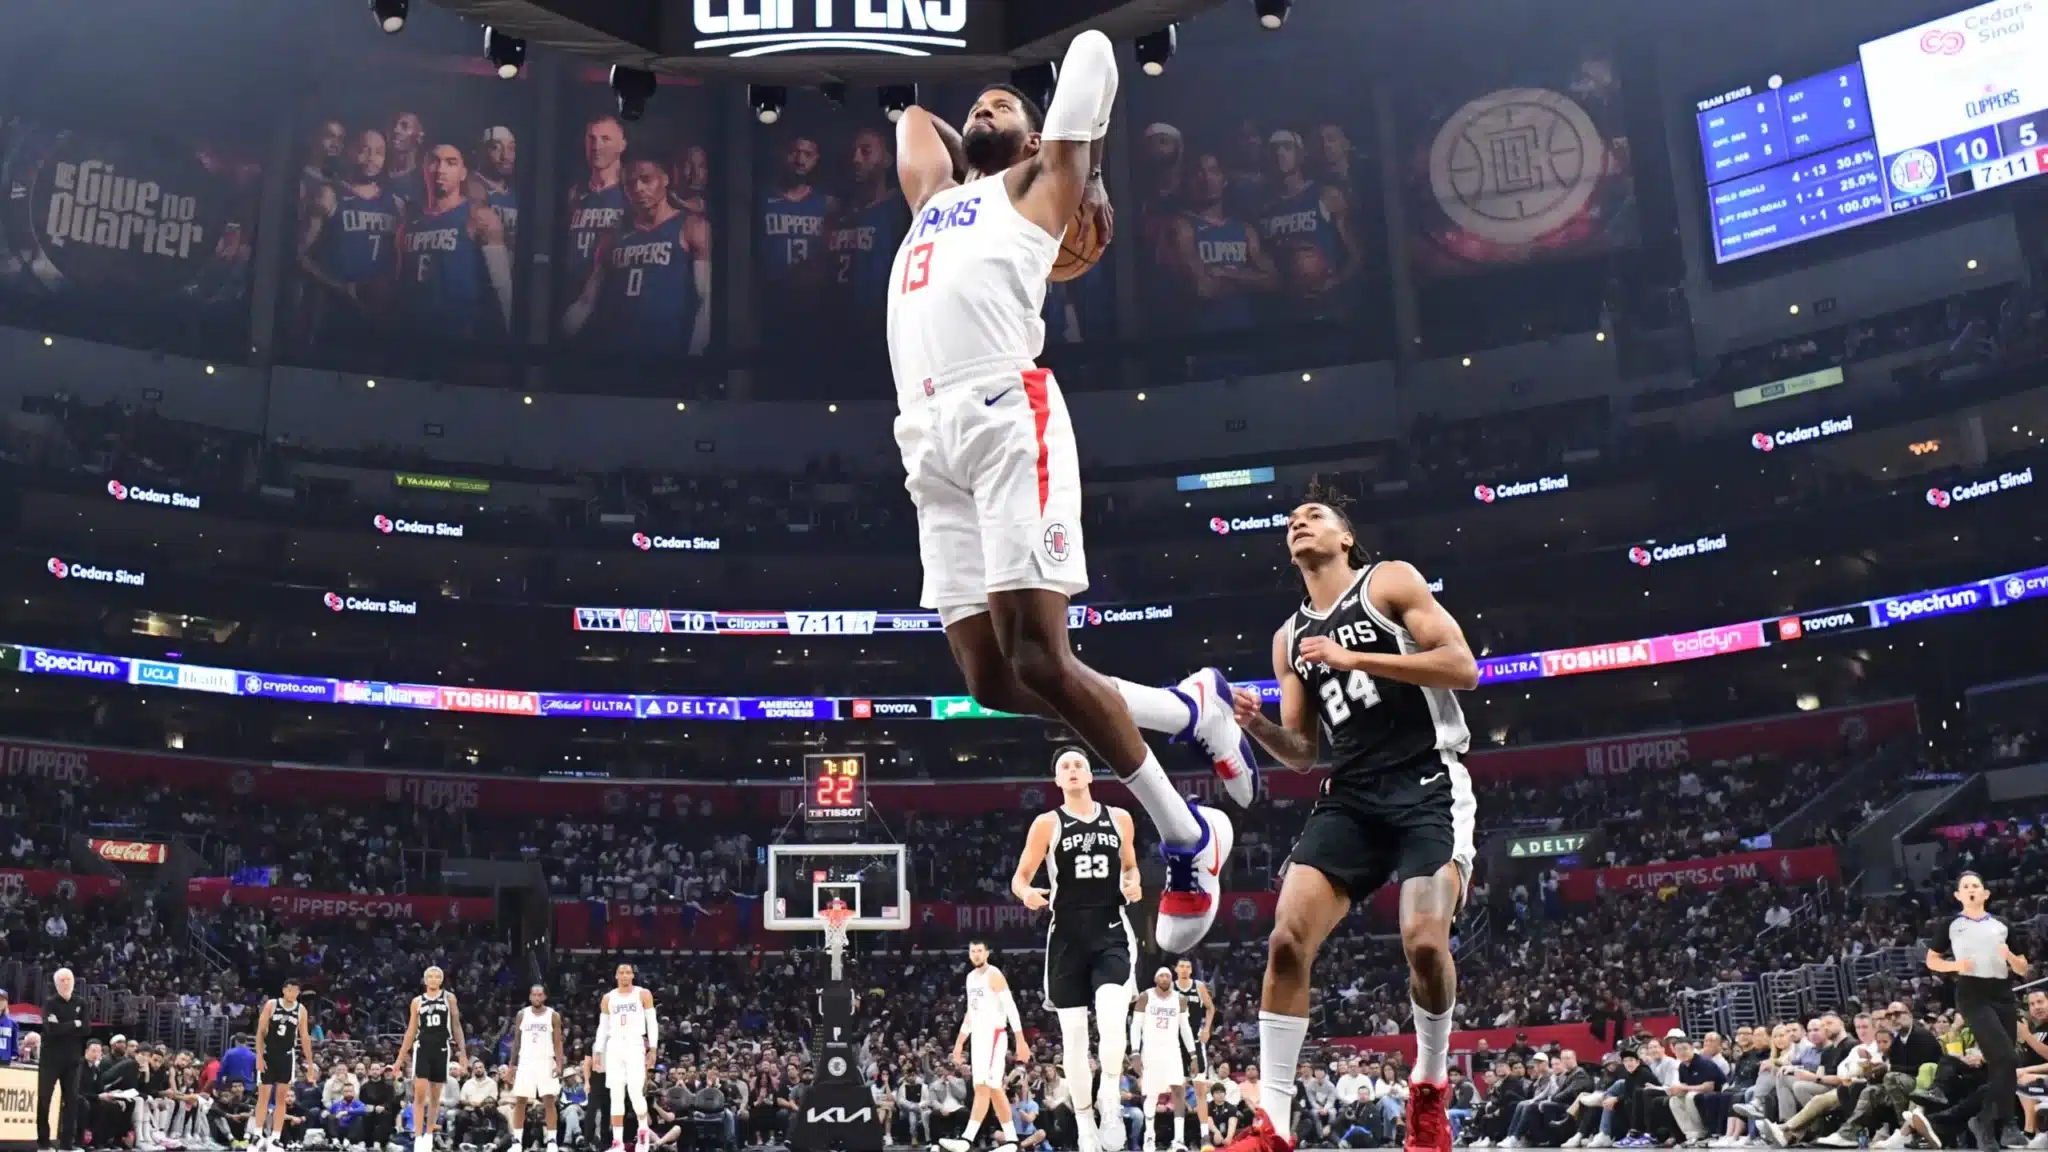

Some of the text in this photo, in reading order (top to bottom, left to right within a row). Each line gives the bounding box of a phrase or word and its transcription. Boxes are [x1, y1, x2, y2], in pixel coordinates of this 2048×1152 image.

[1965, 1, 2033, 30] Cedars
[1979, 19, 2025, 43] Sinai
[1697, 86, 1752, 111] TEAM STATS
[1966, 88, 2020, 118] CLIPPERS
[1955, 122, 2038, 164] 10 5
[1739, 183, 1766, 198] GOALS
[1812, 164, 1827, 177] 13
[1982, 156, 2027, 183] 7:11
[1816, 187, 1824, 198] 4
[1840, 172, 1878, 192] 25.0%
[161, 193, 196, 221] no
[1837, 194, 1882, 215] 100.0%
[47, 192, 203, 259] Quarter
[369, 234, 381, 262] 7
[613, 241, 672, 269] CLIPPERS
[787, 238, 808, 265] 13
[901, 241, 934, 294] 13
[626, 268, 643, 297] 0
[1776, 415, 1853, 445] Cedars Sinai
[1200, 469, 1250, 481] AMERICAN
[1207, 477, 1251, 489] EXPRESS
[1497, 474, 1568, 498] Cedars Sinai
[1952, 467, 2033, 501] Cedars Sinai
[130, 487, 200, 508] Cedars Sinai
[395, 519, 463, 537] Cedars Sinai
[1231, 514, 1289, 530] Cedars Sin
[653, 536, 720, 549] Cedars Sinai
[1653, 533, 1727, 561] Cedars Sinai
[71, 564, 145, 586] Cedars Sinai
[346, 597, 416, 614] Cedars Sinai
[1104, 605, 1173, 623] Cedars Sinai
[1886, 589, 1976, 620] Spectrum
[681, 613, 705, 631] 10
[727, 617, 778, 630] Clippers
[797, 615, 844, 632] 7:11
[893, 617, 929, 630] Spurs
[1802, 613, 1854, 631] TOYOTA
[1672, 629, 1742, 653] boldyn
[35, 651, 115, 675] Spectrum
[1495, 660, 1538, 675] ULTRA
[1548, 644, 1647, 671] TOSHIBA
[143, 667, 174, 681] UCLA
[263, 680, 326, 695] crypto.com
[1319, 669, 1382, 727] 24
[444, 691, 533, 711] TOSHIBA
[592, 701, 633, 711] ULTRA
[667, 700, 729, 715] DELTA
[758, 700, 814, 709] AMERICAN
[766, 708, 814, 718] EXPRESS
[873, 703, 917, 714] TOYOTA
[823, 759, 858, 776] 7:10
[1607, 737, 1691, 775] CLIPPERS
[817, 776, 853, 806] 22
[825, 808, 863, 817] TISSOT
[1062, 832, 1119, 852] SPURS
[1075, 854, 1109, 879] 23
[277, 1024, 287, 1036] 3
[426, 1014, 440, 1027] 10
